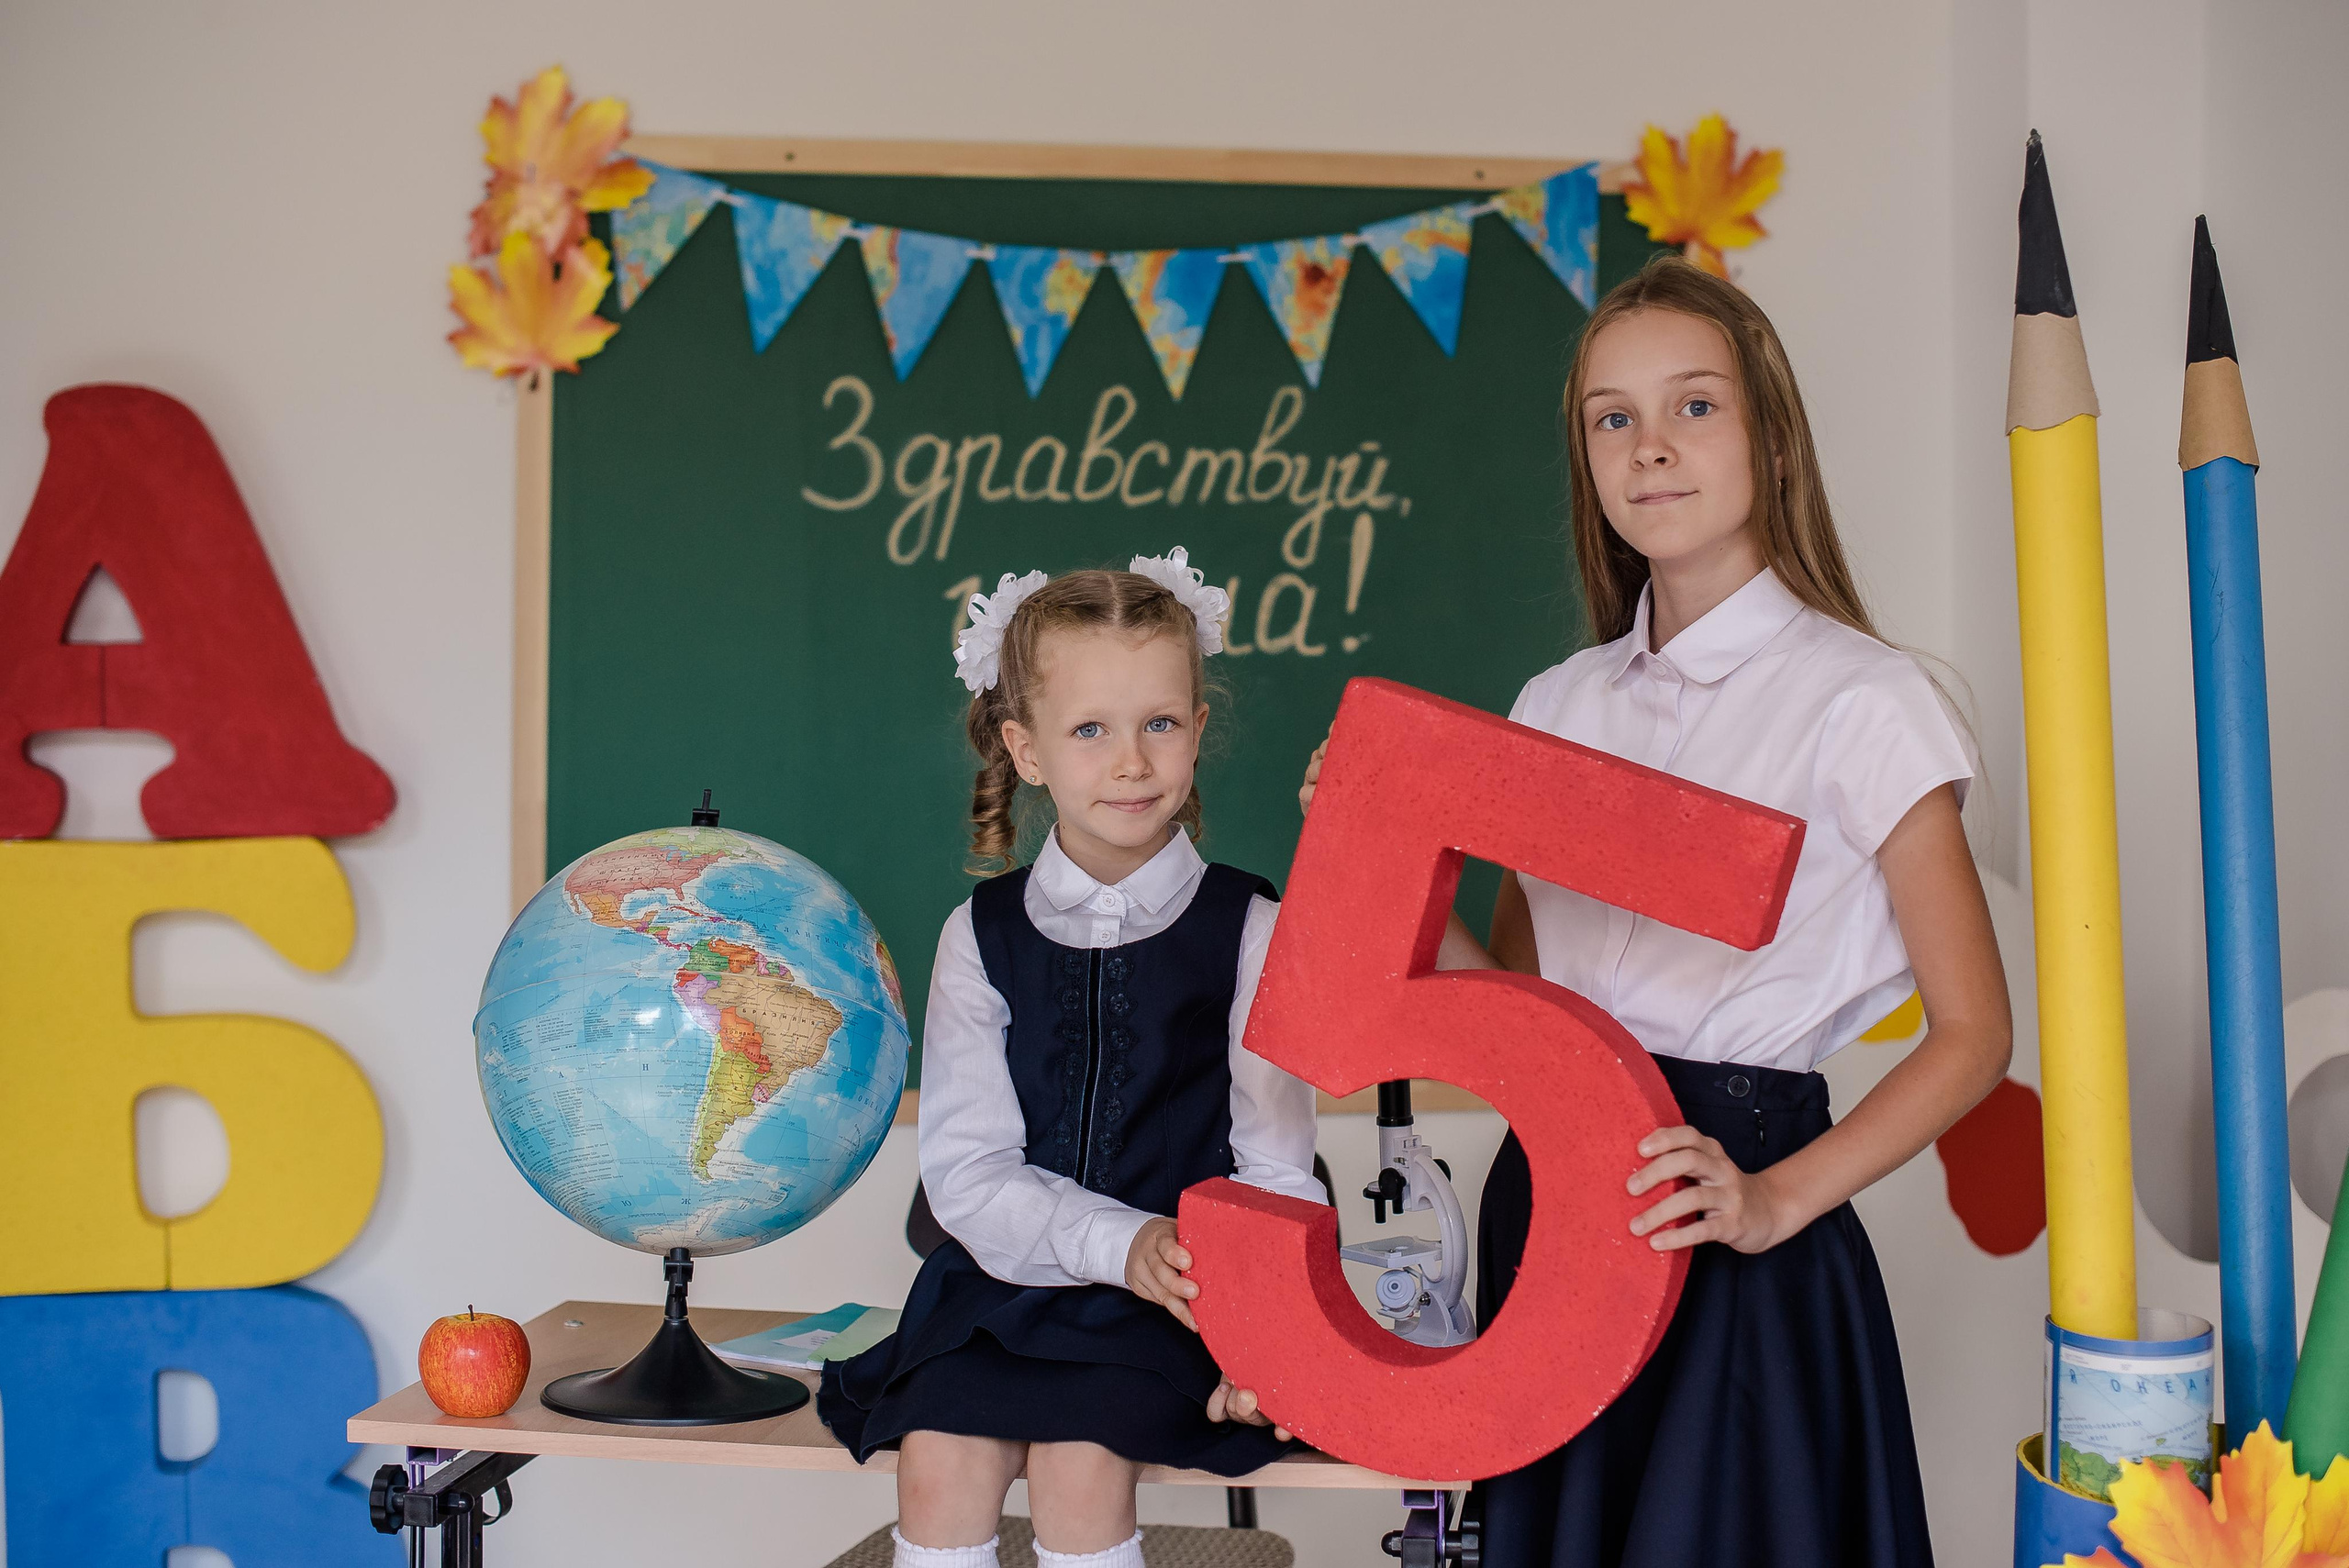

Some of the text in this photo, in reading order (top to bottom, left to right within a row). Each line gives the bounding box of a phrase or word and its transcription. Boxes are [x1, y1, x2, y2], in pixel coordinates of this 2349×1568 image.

[0, 384, 397, 840] А
[801, 375, 1413, 567] Здравствуй,
[0, 836, 385, 1296] Б
[741, 1007, 816, 1026] БРАЗИЛИЯ
[1177, 676, 1808, 1481] 5
